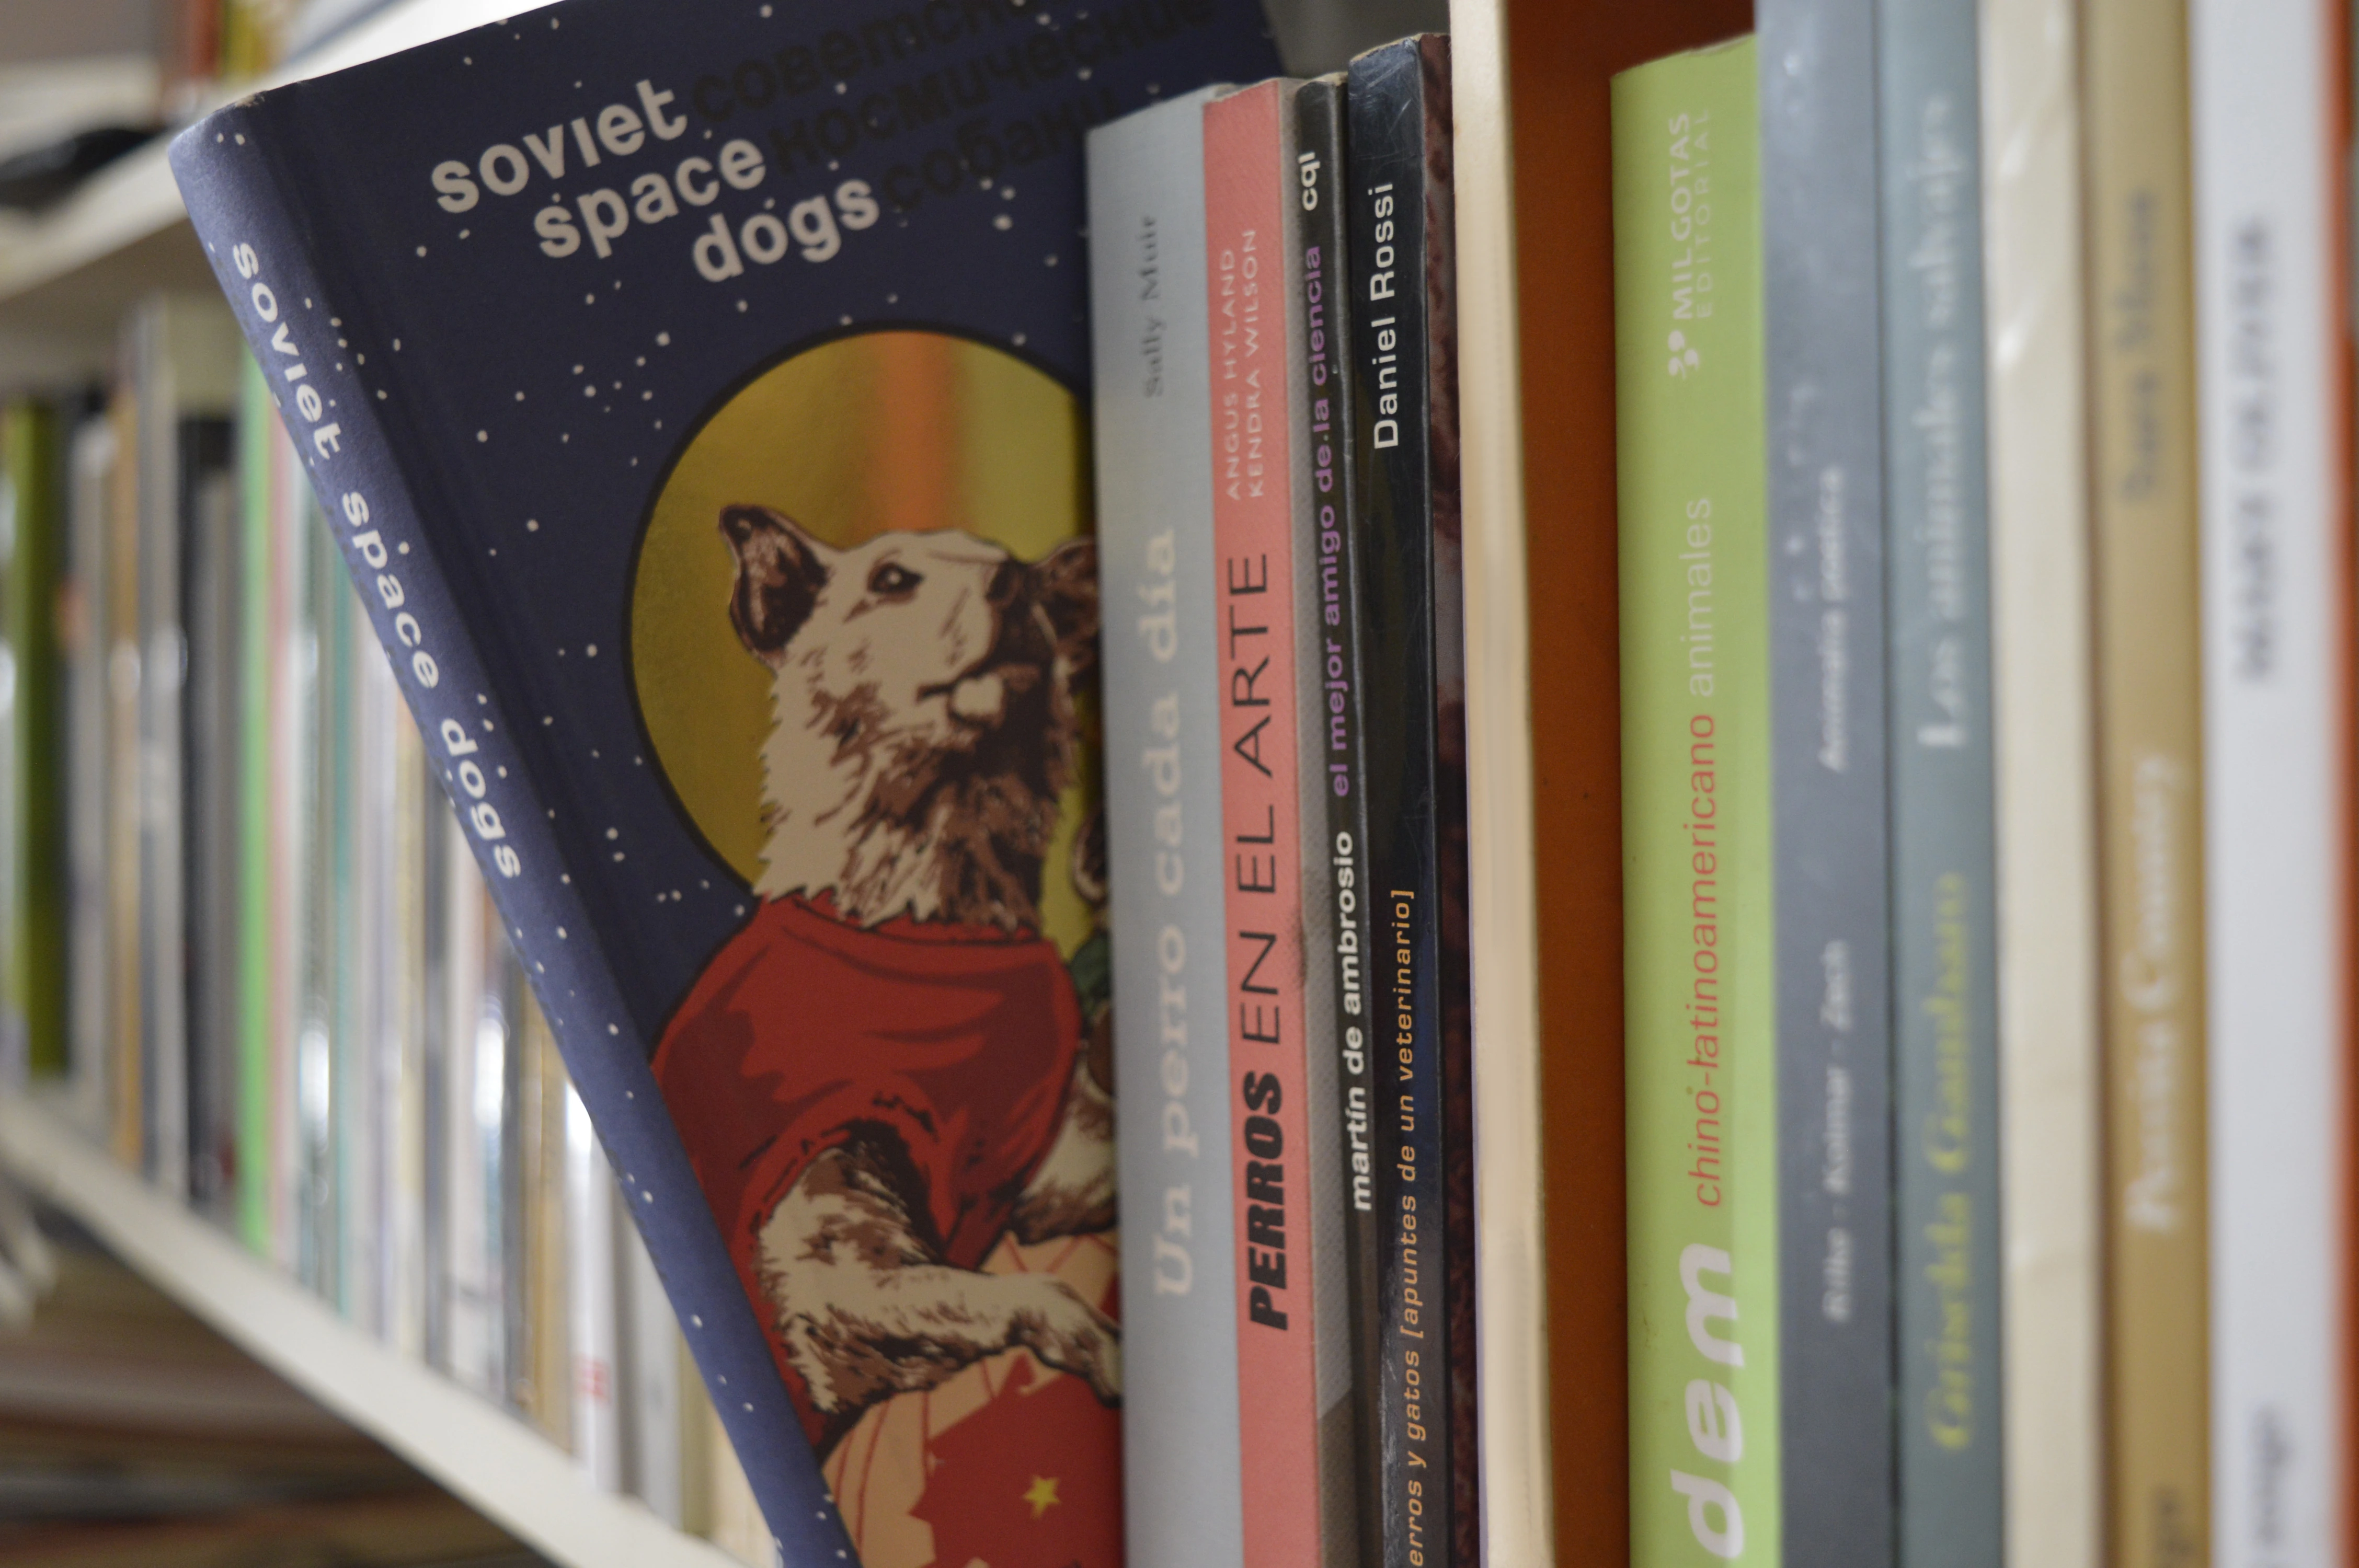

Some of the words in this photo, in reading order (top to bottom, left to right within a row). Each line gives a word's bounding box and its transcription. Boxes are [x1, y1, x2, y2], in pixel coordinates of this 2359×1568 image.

[431, 79, 688, 213] soviet
[534, 138, 765, 258] space
[1298, 151, 1321, 211] cql
[1669, 112, 1692, 242] GOTAS
[693, 181, 880, 282] dogs
[1136, 215, 1159, 303] Muir
[1368, 183, 1395, 301] Rossi
[1694, 109, 1714, 319] EDITORIAL
[1220, 248, 1238, 381] HYLAND
[1242, 228, 1260, 358] WILSON
[1304, 246, 1327, 386] ciencia
[1672, 248, 1694, 319] MIL
[1138, 315, 1167, 399] Sally
[1313, 398, 1331, 433] la
[1371, 316, 1399, 449] Daniel
[1223, 391, 1242, 501] ANGUS
[1245, 368, 1265, 498] KENDRA
[1315, 444, 1334, 492] de
[233, 242, 341, 459] soviet
[343, 492, 439, 688] space
[441, 718, 521, 879] dogs
[1137, 527, 1178, 664] día
[1319, 504, 1342, 626] amigo
[1679, 497, 1715, 698] animales
[1227, 554, 1273, 778] ARTE
[1324, 638, 1349, 751] mejor
[1142, 691, 1185, 897] cada
[1330, 763, 1350, 797] el
[1235, 805, 1276, 894] EL
[1334, 831, 1362, 1016] ambrosio
[1683, 714, 1722, 1208] chino-latinoamericano
[1156, 924, 1200, 1158] perro
[1238, 930, 1280, 1045] EN
[1390, 889, 1415, 1081] veterinario]
[1343, 1026, 1364, 1075] de
[1345, 1087, 1371, 1211] martín
[1396, 1145, 1416, 1182] de
[1399, 1097, 1416, 1132] un
[1153, 1183, 1195, 1297] Un
[1242, 1070, 1288, 1331] PERROS
[1400, 1195, 1425, 1340] [apuntes
[1403, 1350, 1427, 1441] gatos
[1670, 1242, 1745, 1560] dem
[1407, 1451, 1427, 1468] y
[1407, 1480, 1424, 1567] erros
